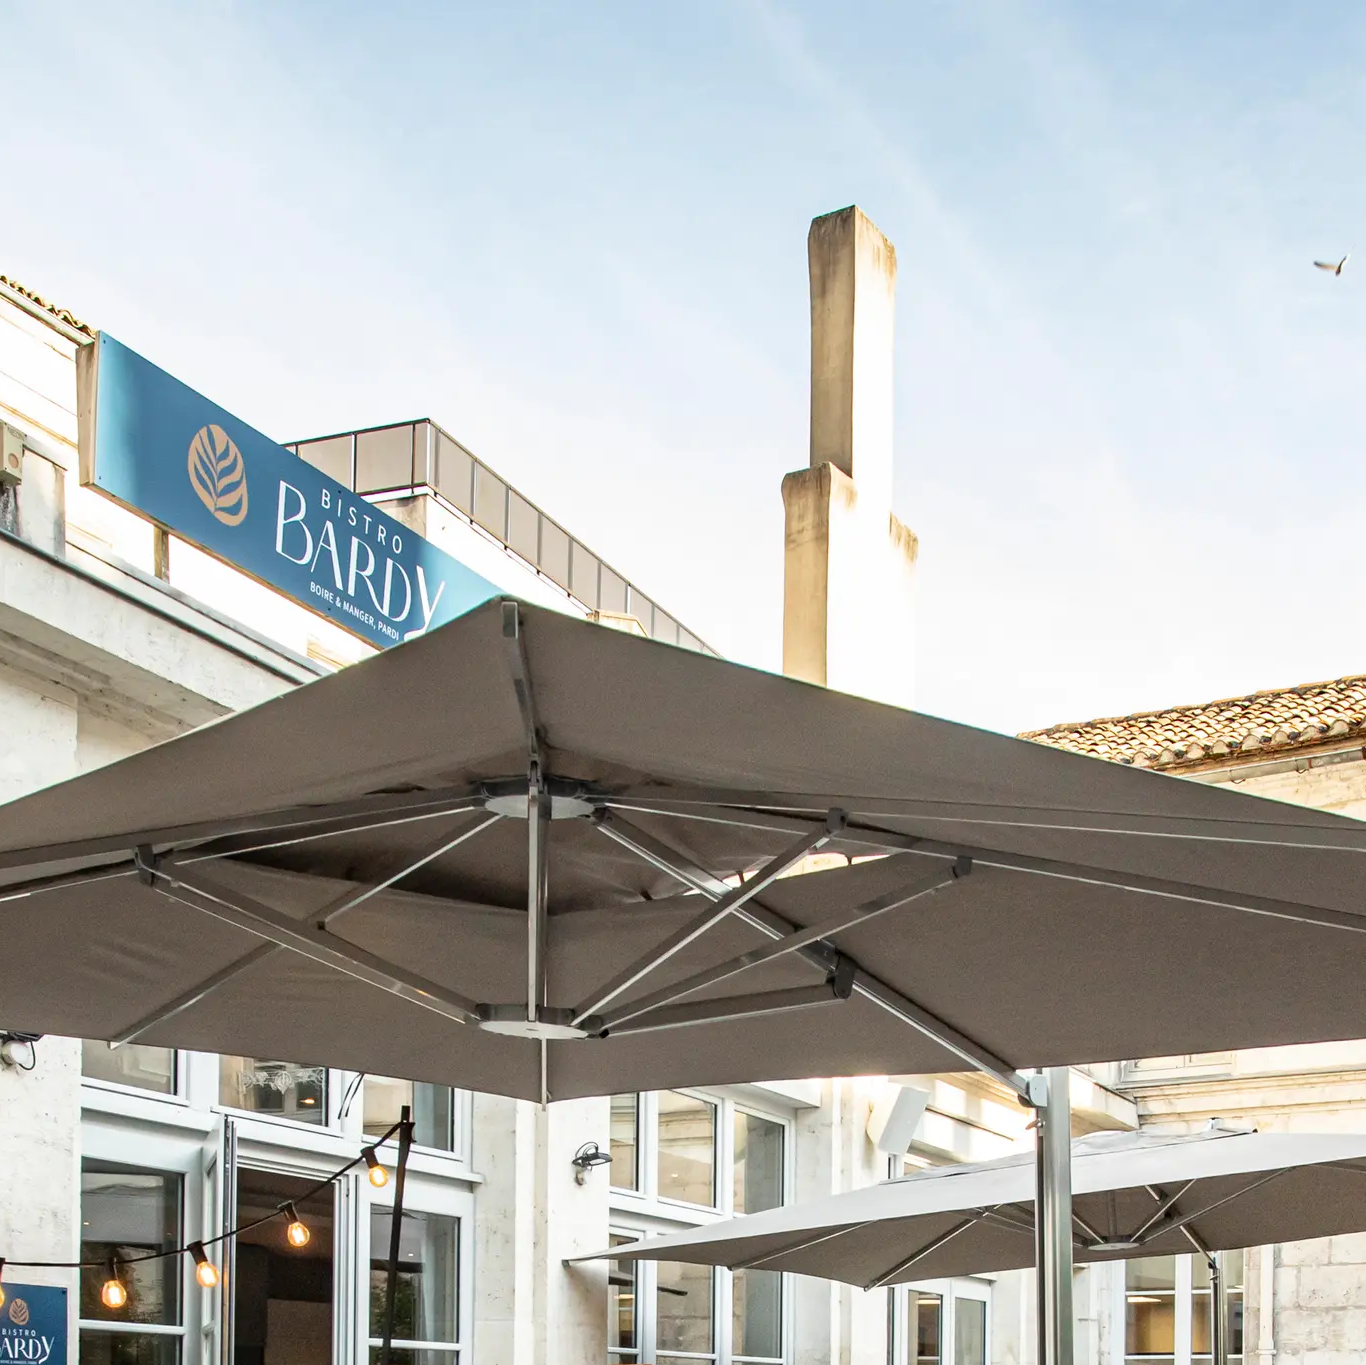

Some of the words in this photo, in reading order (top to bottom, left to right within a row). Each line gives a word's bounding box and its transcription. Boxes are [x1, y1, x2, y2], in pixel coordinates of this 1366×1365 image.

[321, 488, 402, 554] BISTRO
[276, 480, 446, 640] BARDY
[310, 582, 335, 604] BOIRE
[335, 596, 342, 608] &
[343, 600, 376, 630] MANGER,
[378, 621, 399, 641] PARDI
[2, 1328, 36, 1337] BISTRO
